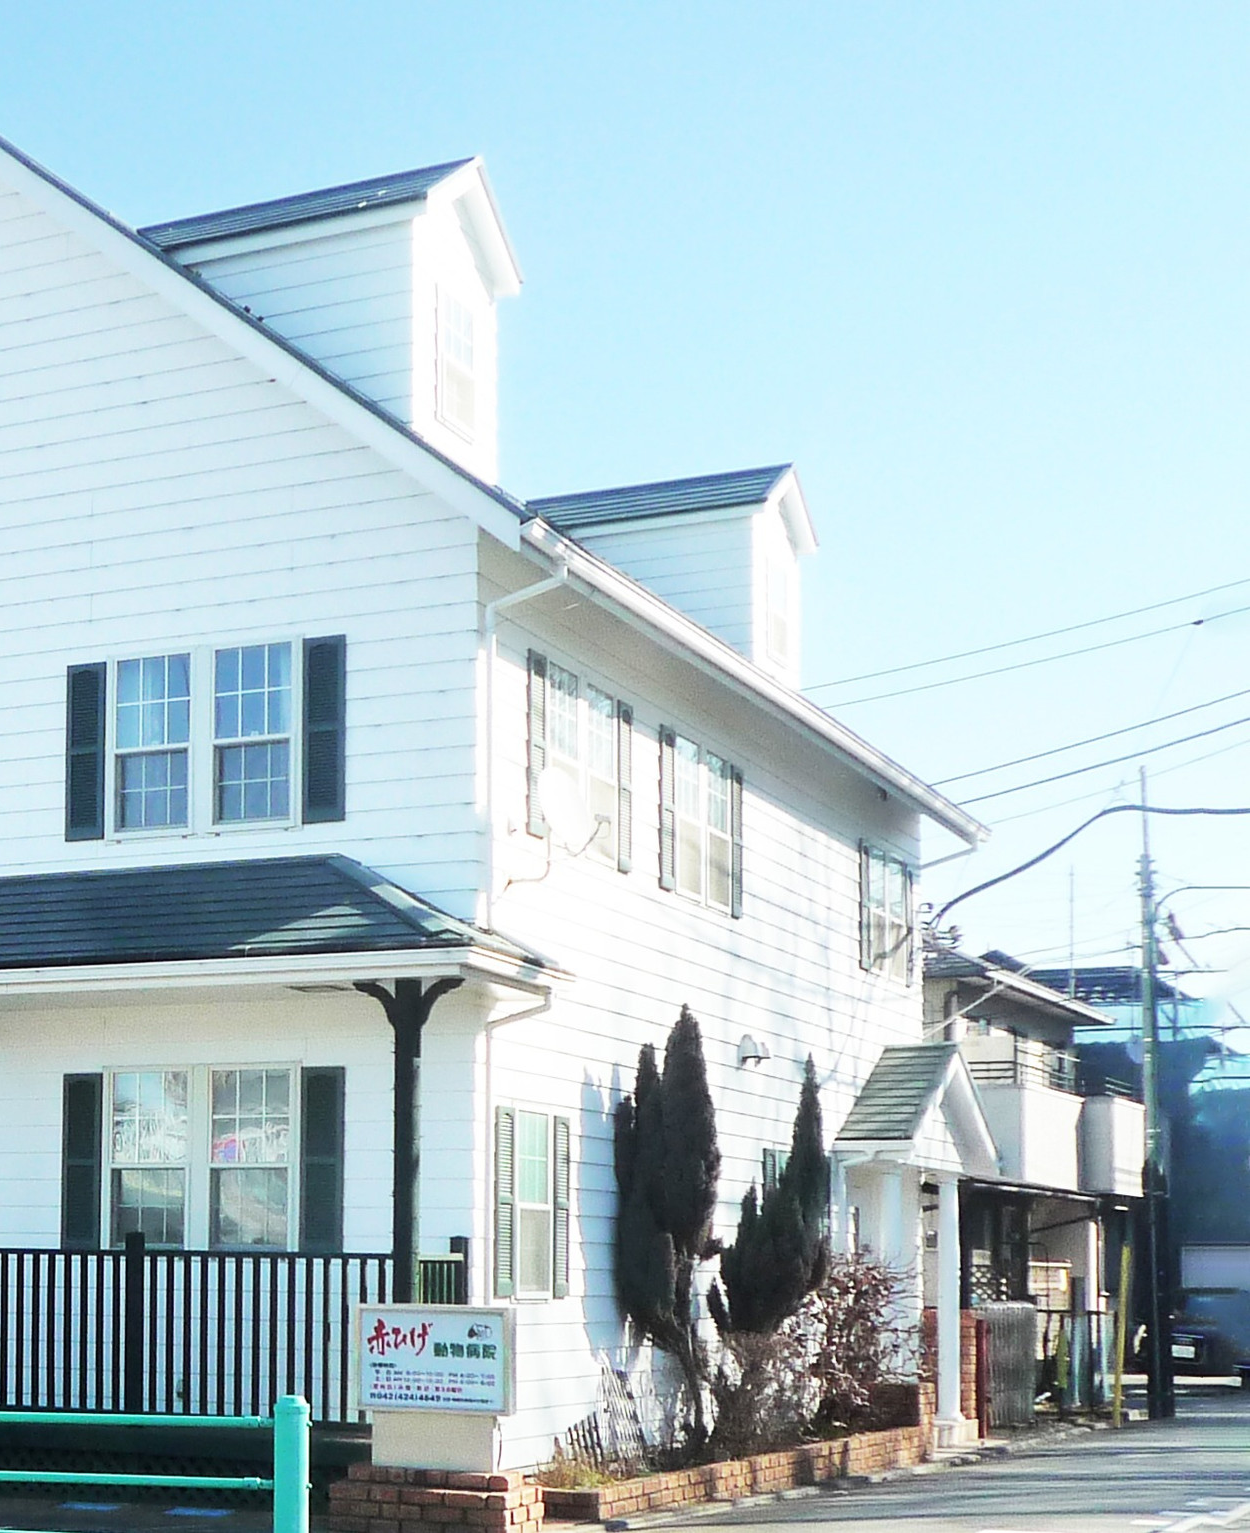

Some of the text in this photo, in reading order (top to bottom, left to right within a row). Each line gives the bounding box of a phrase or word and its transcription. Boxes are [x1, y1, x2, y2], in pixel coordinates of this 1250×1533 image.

[367, 1318, 498, 1360] 赤ひげ 動物病院
